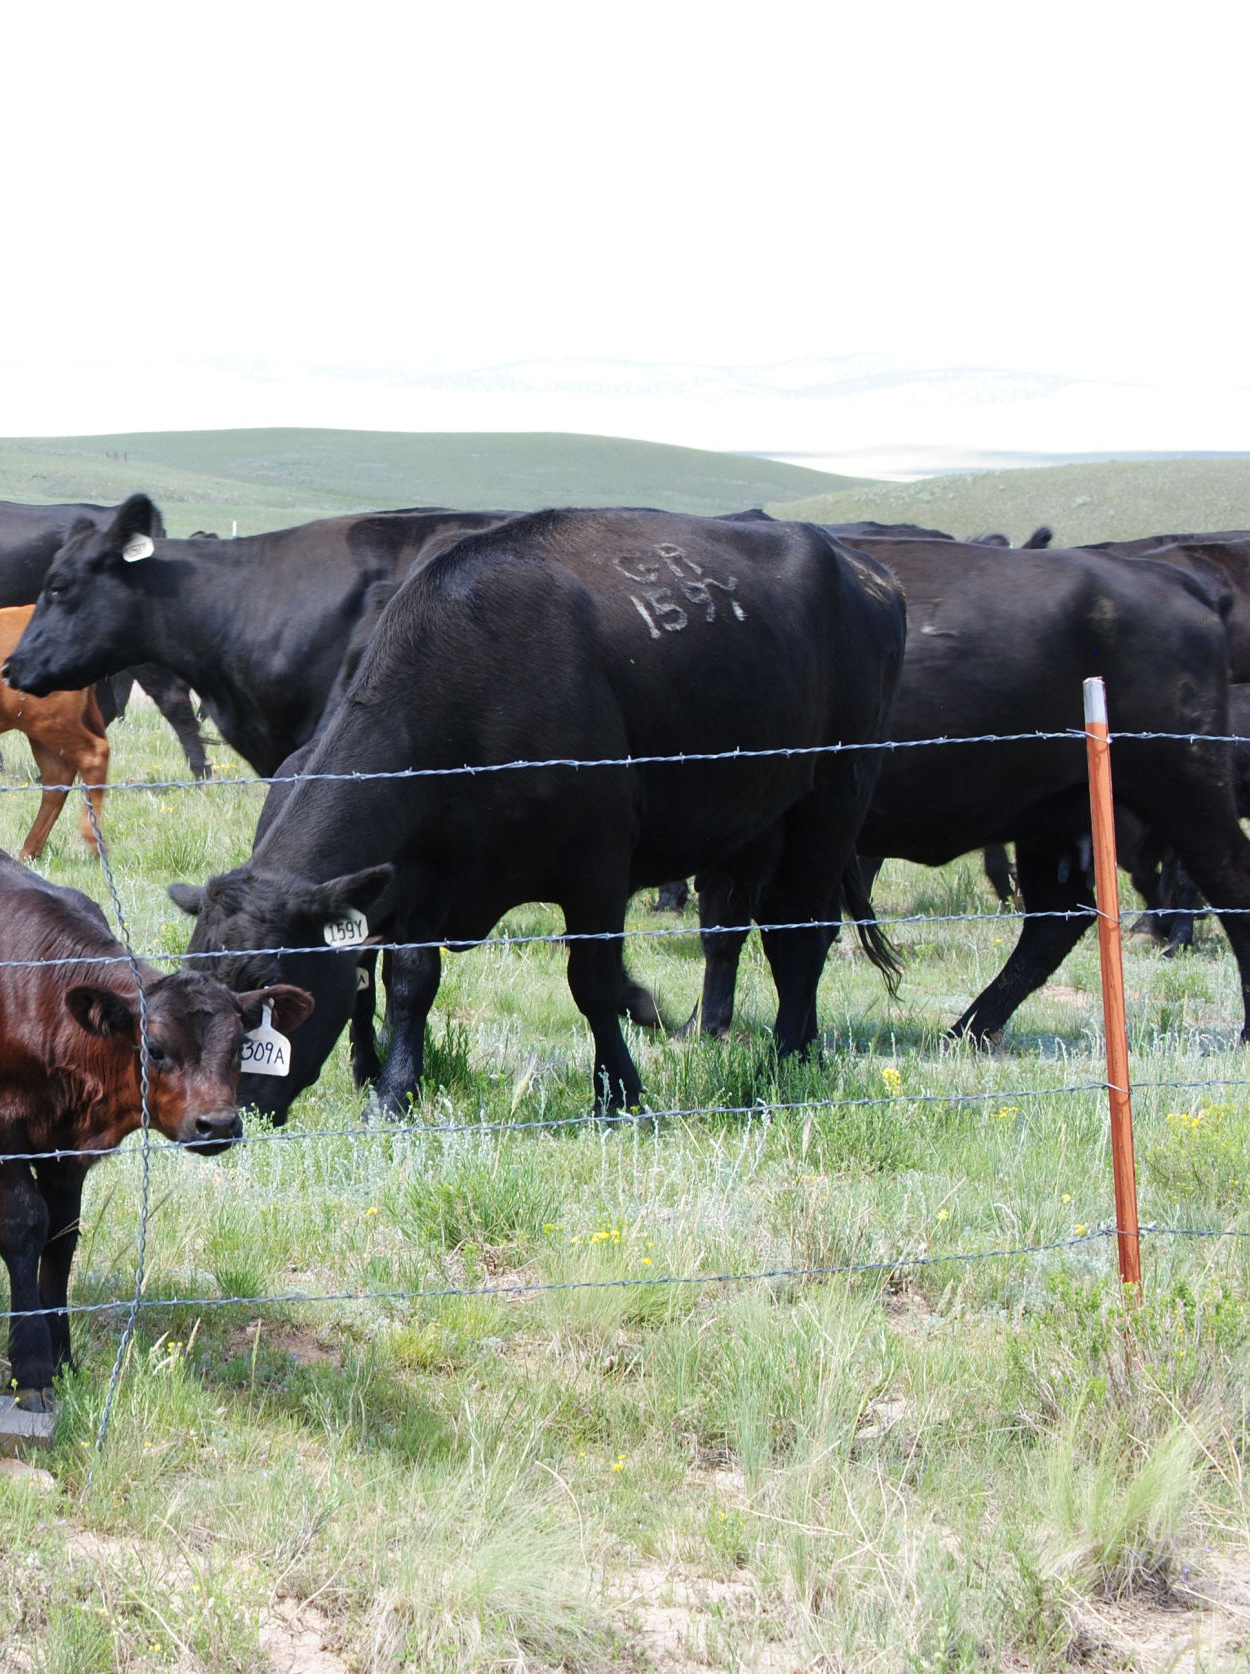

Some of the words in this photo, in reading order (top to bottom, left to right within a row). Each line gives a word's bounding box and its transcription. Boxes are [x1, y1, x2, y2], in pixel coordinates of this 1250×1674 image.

[613, 543, 704, 584] GR
[630, 576, 748, 640] 159Y
[330, 919, 362, 942] 159Y
[240, 1038, 284, 1064] 309A
